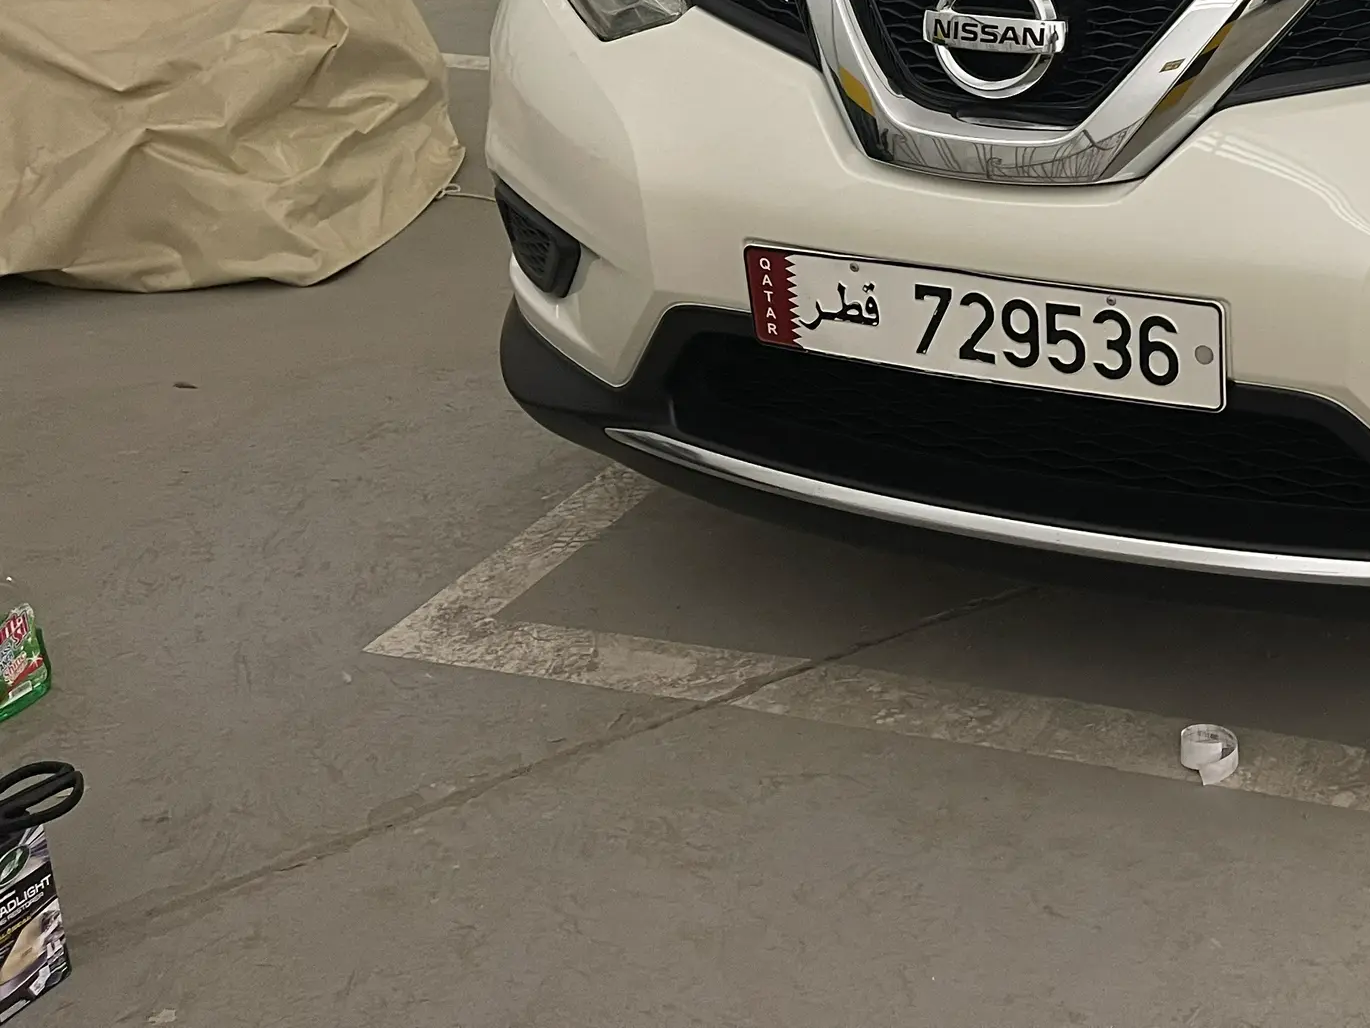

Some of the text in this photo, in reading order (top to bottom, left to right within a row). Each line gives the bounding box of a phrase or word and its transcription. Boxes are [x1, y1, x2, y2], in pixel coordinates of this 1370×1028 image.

[933, 19, 1045, 46] NISSAN
[760, 257, 778, 335] QATAR
[799, 281, 879, 330] قطر
[914, 283, 1179, 386] 729536
[0, 874, 52, 919] ADLIGHT
